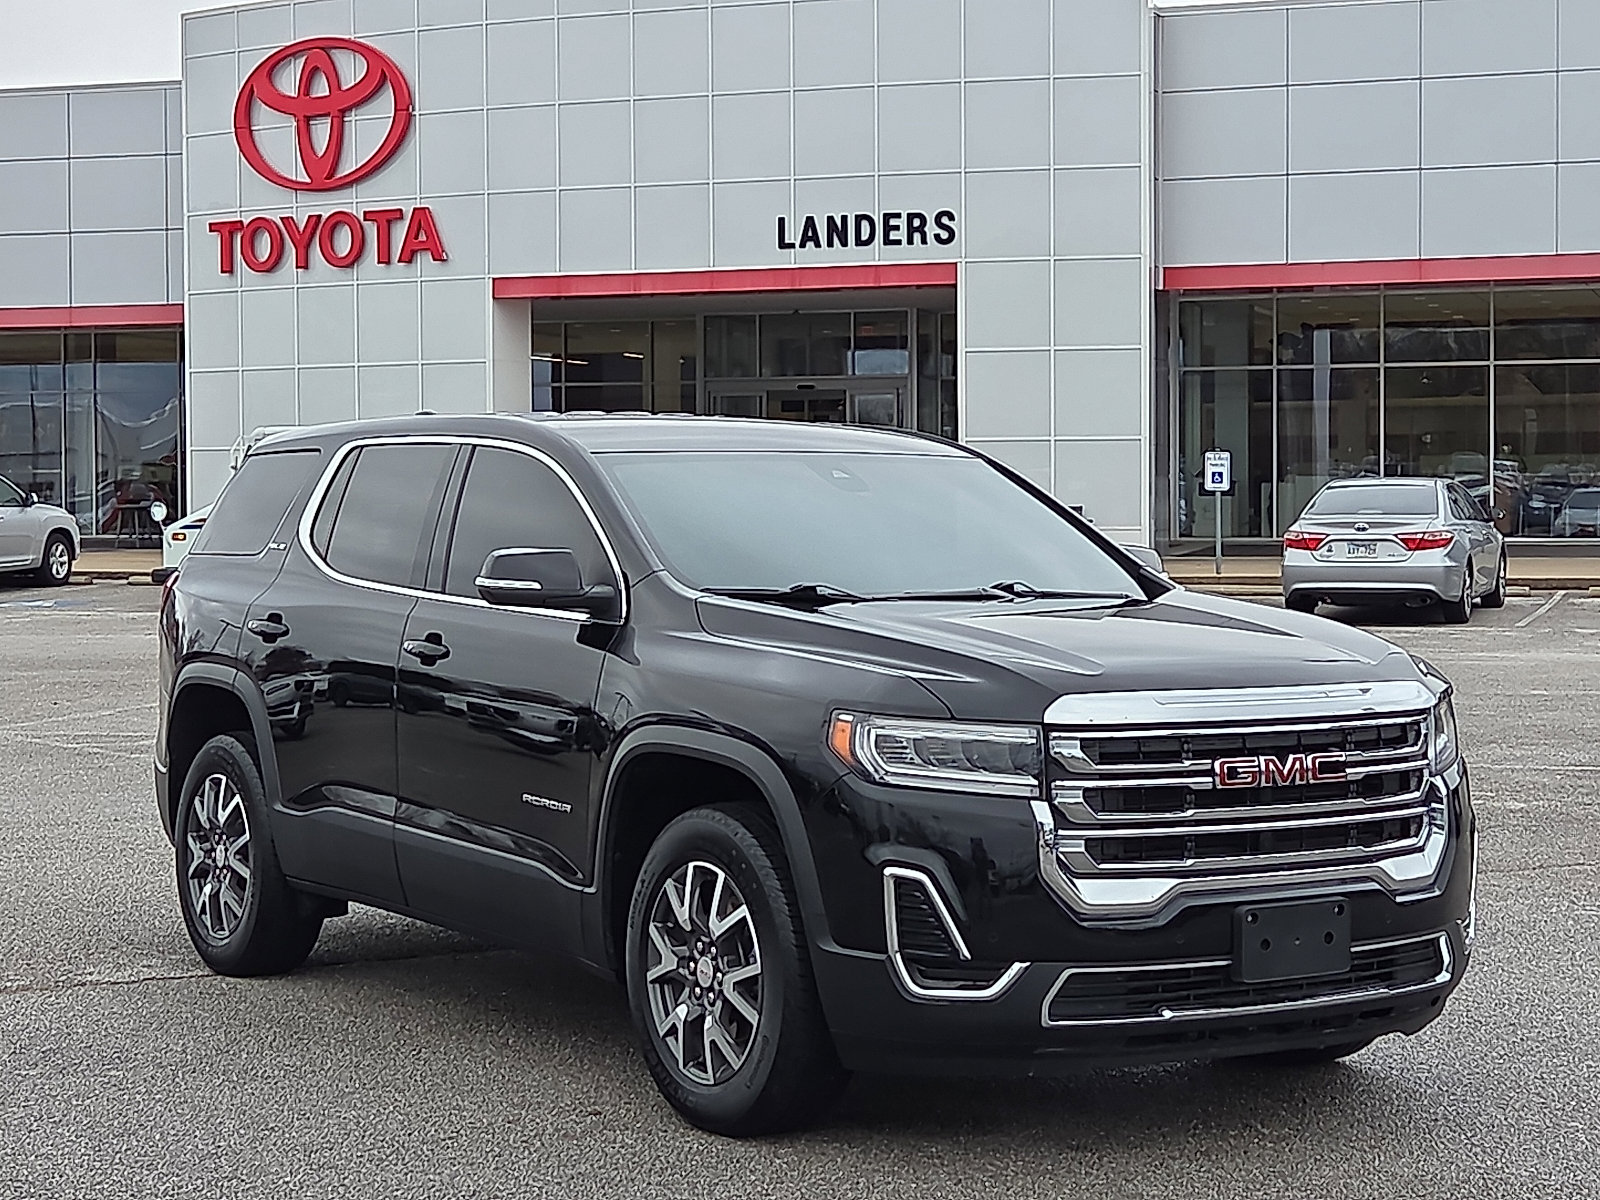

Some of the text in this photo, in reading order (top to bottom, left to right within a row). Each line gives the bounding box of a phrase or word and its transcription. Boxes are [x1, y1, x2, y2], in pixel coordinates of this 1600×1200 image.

[208, 206, 447, 274] TOYOTA
[777, 210, 957, 250] LANDERS
[1214, 752, 1347, 789] GMC
